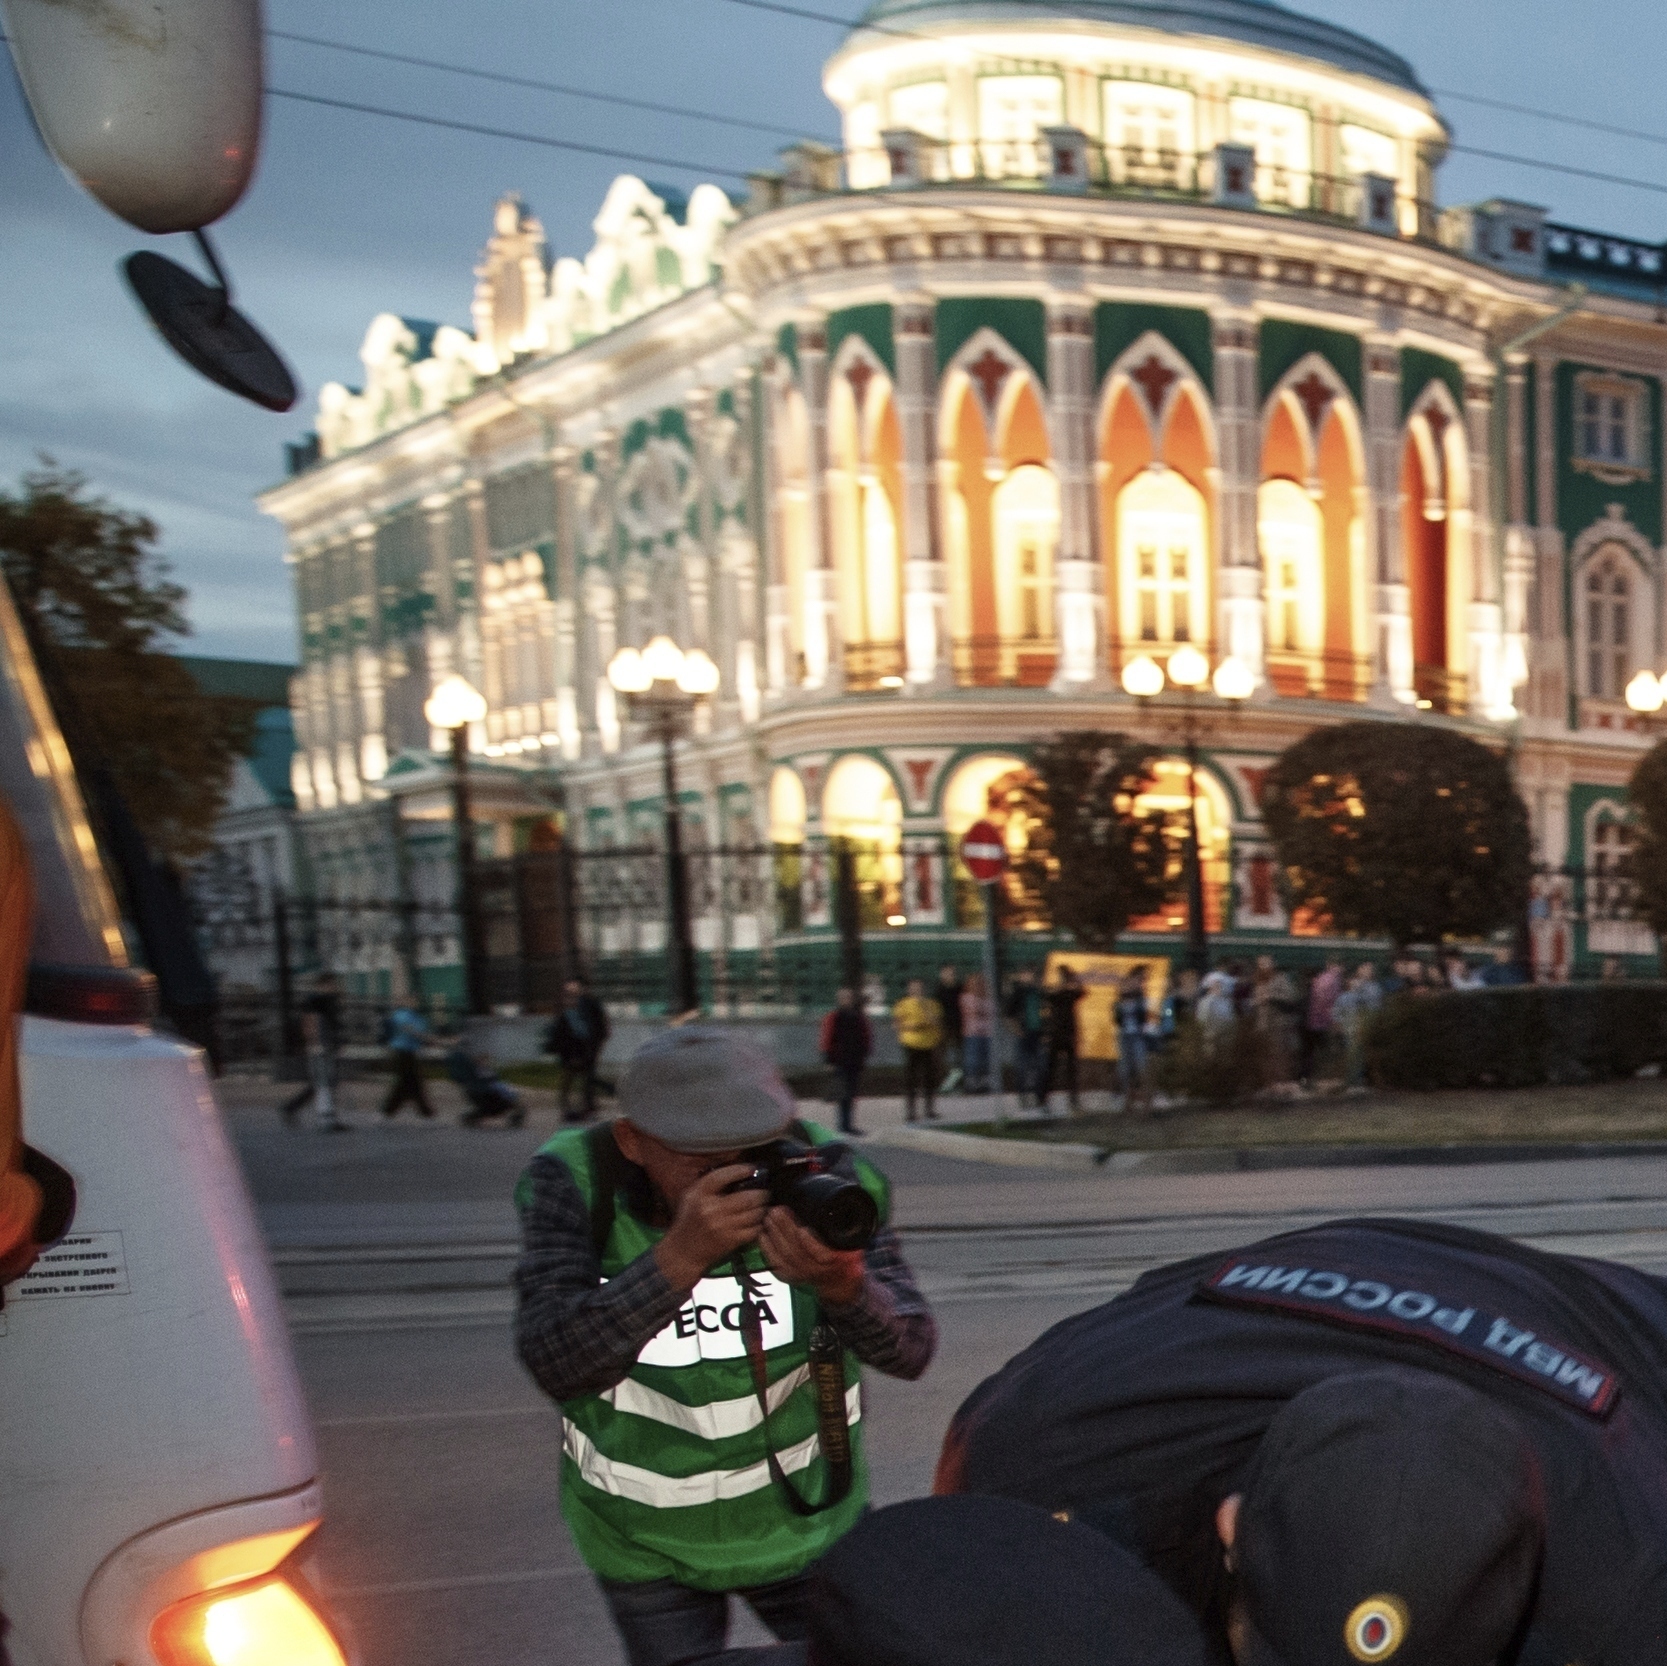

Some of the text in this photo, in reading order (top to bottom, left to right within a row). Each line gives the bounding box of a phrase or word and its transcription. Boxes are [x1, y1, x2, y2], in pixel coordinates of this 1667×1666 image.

[673, 1299, 779, 1339] ЕССА
[1217, 1263, 1606, 1400] МВД РОССИИ
